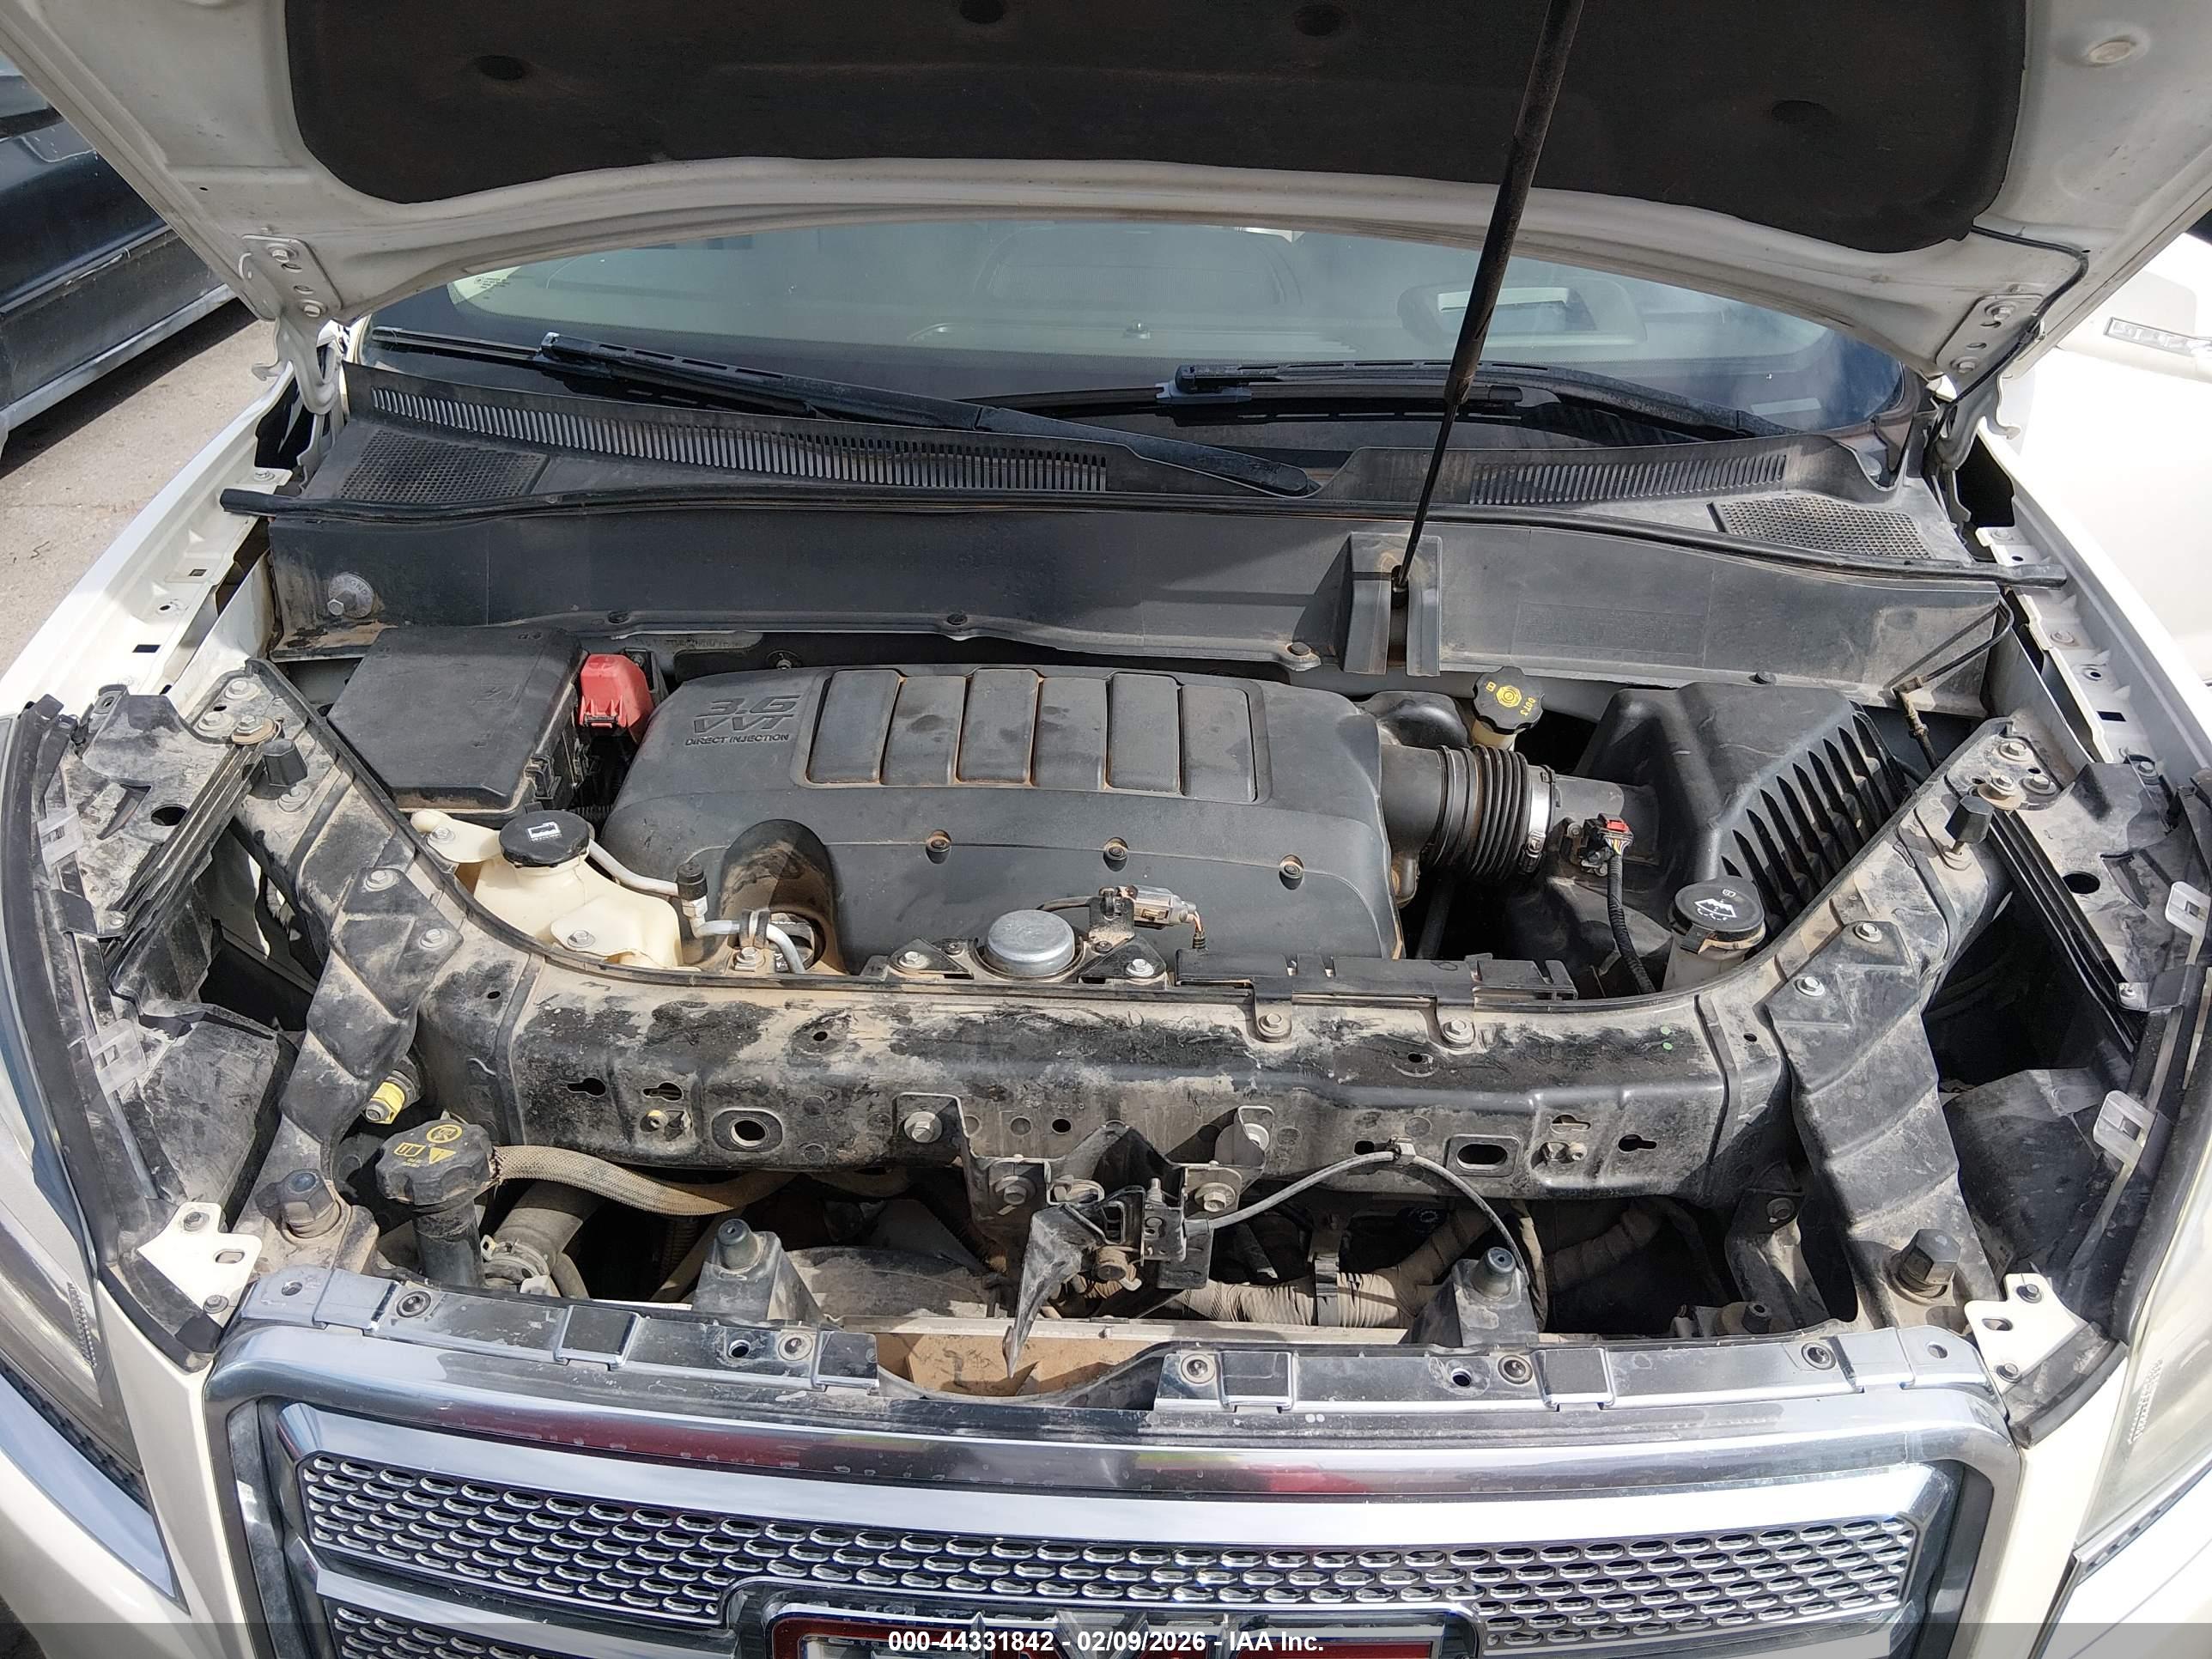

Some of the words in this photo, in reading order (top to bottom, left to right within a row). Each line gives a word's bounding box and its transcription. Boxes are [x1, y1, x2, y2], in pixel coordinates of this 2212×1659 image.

[696, 695, 801, 717] 3.6
[1524, 697, 1536, 712] DOT
[694, 714, 794, 733] VVT
[685, 736, 728, 746] DIRECT
[729, 733, 789, 744] INJECTION
